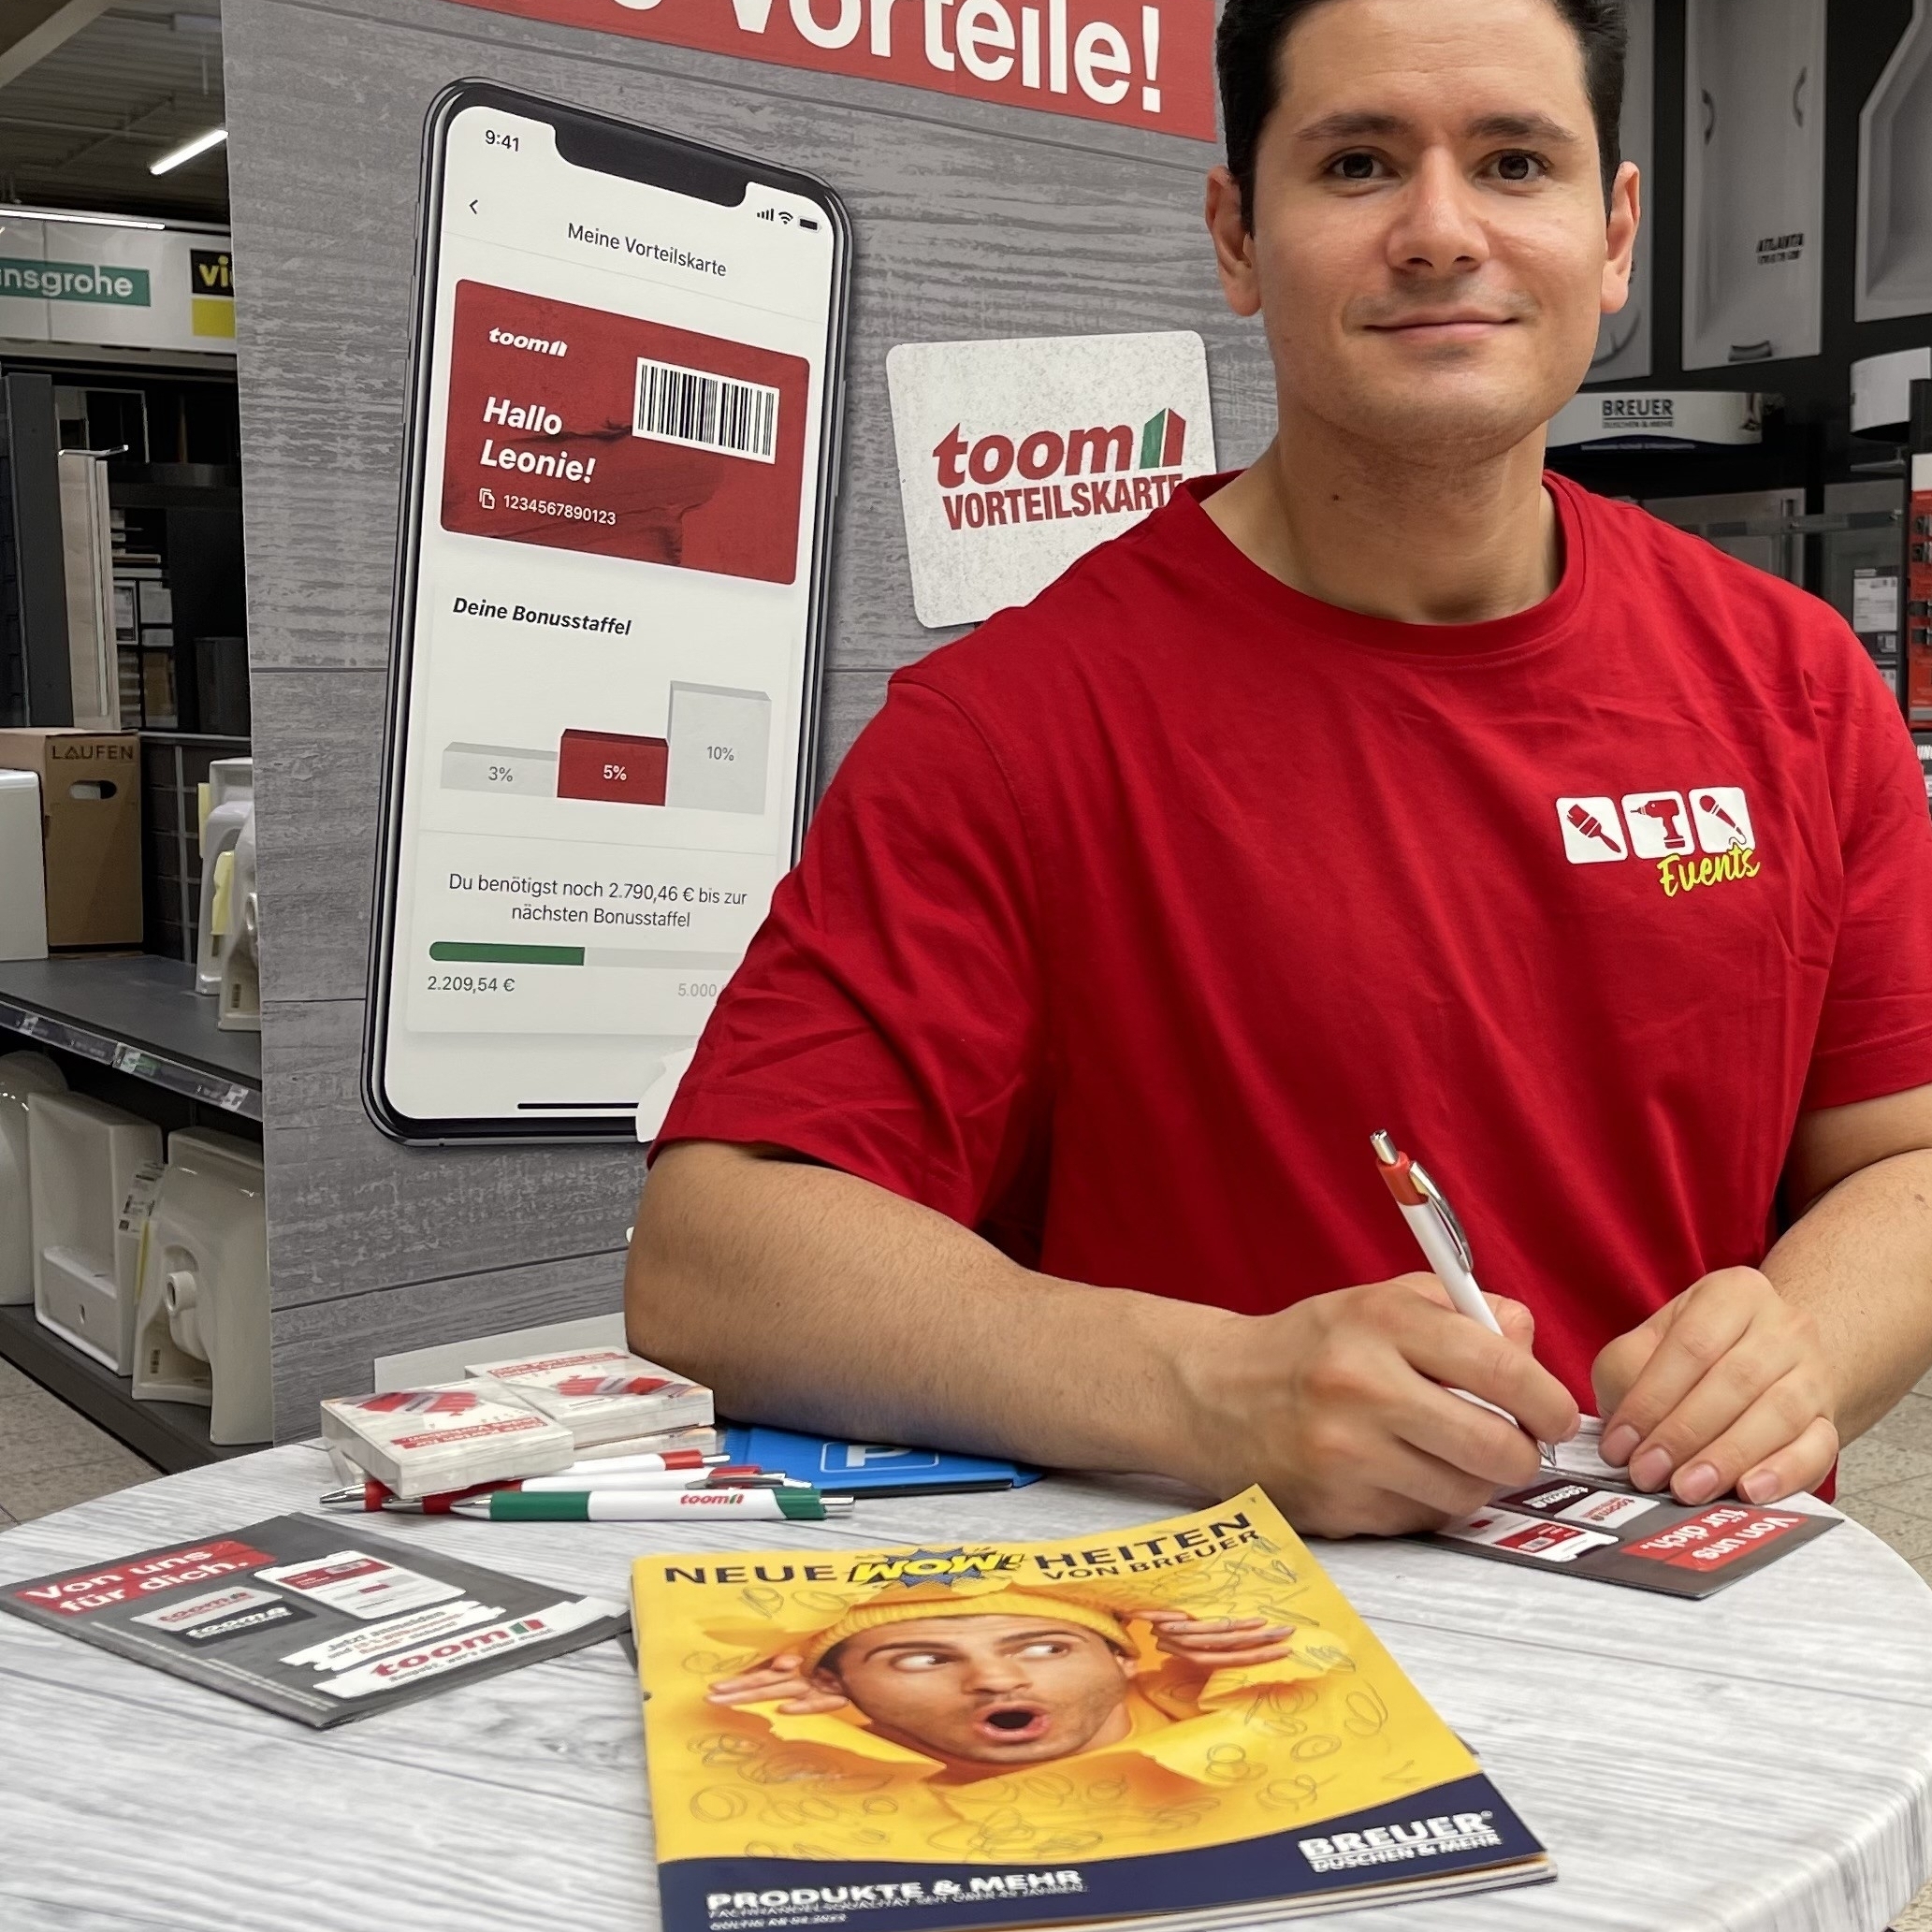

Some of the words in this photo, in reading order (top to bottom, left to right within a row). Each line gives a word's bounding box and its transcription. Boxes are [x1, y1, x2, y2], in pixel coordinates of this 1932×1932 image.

[485, 129, 520, 153] 9:41
[567, 223, 619, 254] Meine
[624, 237, 727, 277] Vorteilskarte
[0, 265, 133, 298] nsgrohe
[199, 255, 233, 287] vi
[489, 327, 550, 354] toom
[483, 397, 562, 435] Hallo
[1603, 399, 1674, 416] BREUER
[480, 439, 596, 484] Leonie!
[932, 422, 1134, 488] toom
[503, 495, 617, 525] 1234567890123
[453, 597, 508, 620] Deine
[512, 605, 632, 636] Bonusstaffel
[51, 745, 133, 760] LAUFEN
[706, 746, 734, 762] 10%
[488, 766, 514, 783] 3%
[603, 764, 627, 781] 5%
[1657, 844, 1760, 897] Events
[449, 873, 473, 892] Du
[478, 875, 558, 898] benötigst
[562, 879, 603, 898] noch
[608, 883, 678, 904] 2.790,46
[683, 886, 695, 902] €
[699, 886, 719, 904] bis
[724, 891, 748, 906] zur
[512, 904, 588, 924] nächsten
[593, 908, 690, 928] Bonusstaffel
[427, 975, 498, 995] 2.209,54
[503, 978, 516, 993] €
[677, 982, 718, 997] 5.000
[680, 1494, 730, 1504] toom
[1701, 1509, 1749, 1528] für
[1735, 1517, 1799, 1539] Von
[665, 1564, 837, 1585] NEUE
[846, 1550, 1025, 1585] WOW!
[1035, 1512, 1251, 1570] HEITEN
[1640, 1525, 1709, 1549] dich.
[1692, 1537, 1747, 1560] uns
[1042, 1566, 1119, 1580] VON
[1129, 1530, 1259, 1573] BREUER
[26, 1573, 123, 1600] Von
[130, 1550, 214, 1575] uns
[60, 1589, 129, 1612] für
[139, 1560, 249, 1591] dich.
[371, 1630, 511, 1677] toom
[1311, 1845, 1415, 1872] DUSCHEN
[1416, 1844, 1436, 1856] &
[1439, 1834, 1503, 1853] MEHR
[706, 1881, 924, 1910] PRODUKTE
[932, 1880, 962, 1896] &
[969, 1869, 1083, 1893] MEHR
